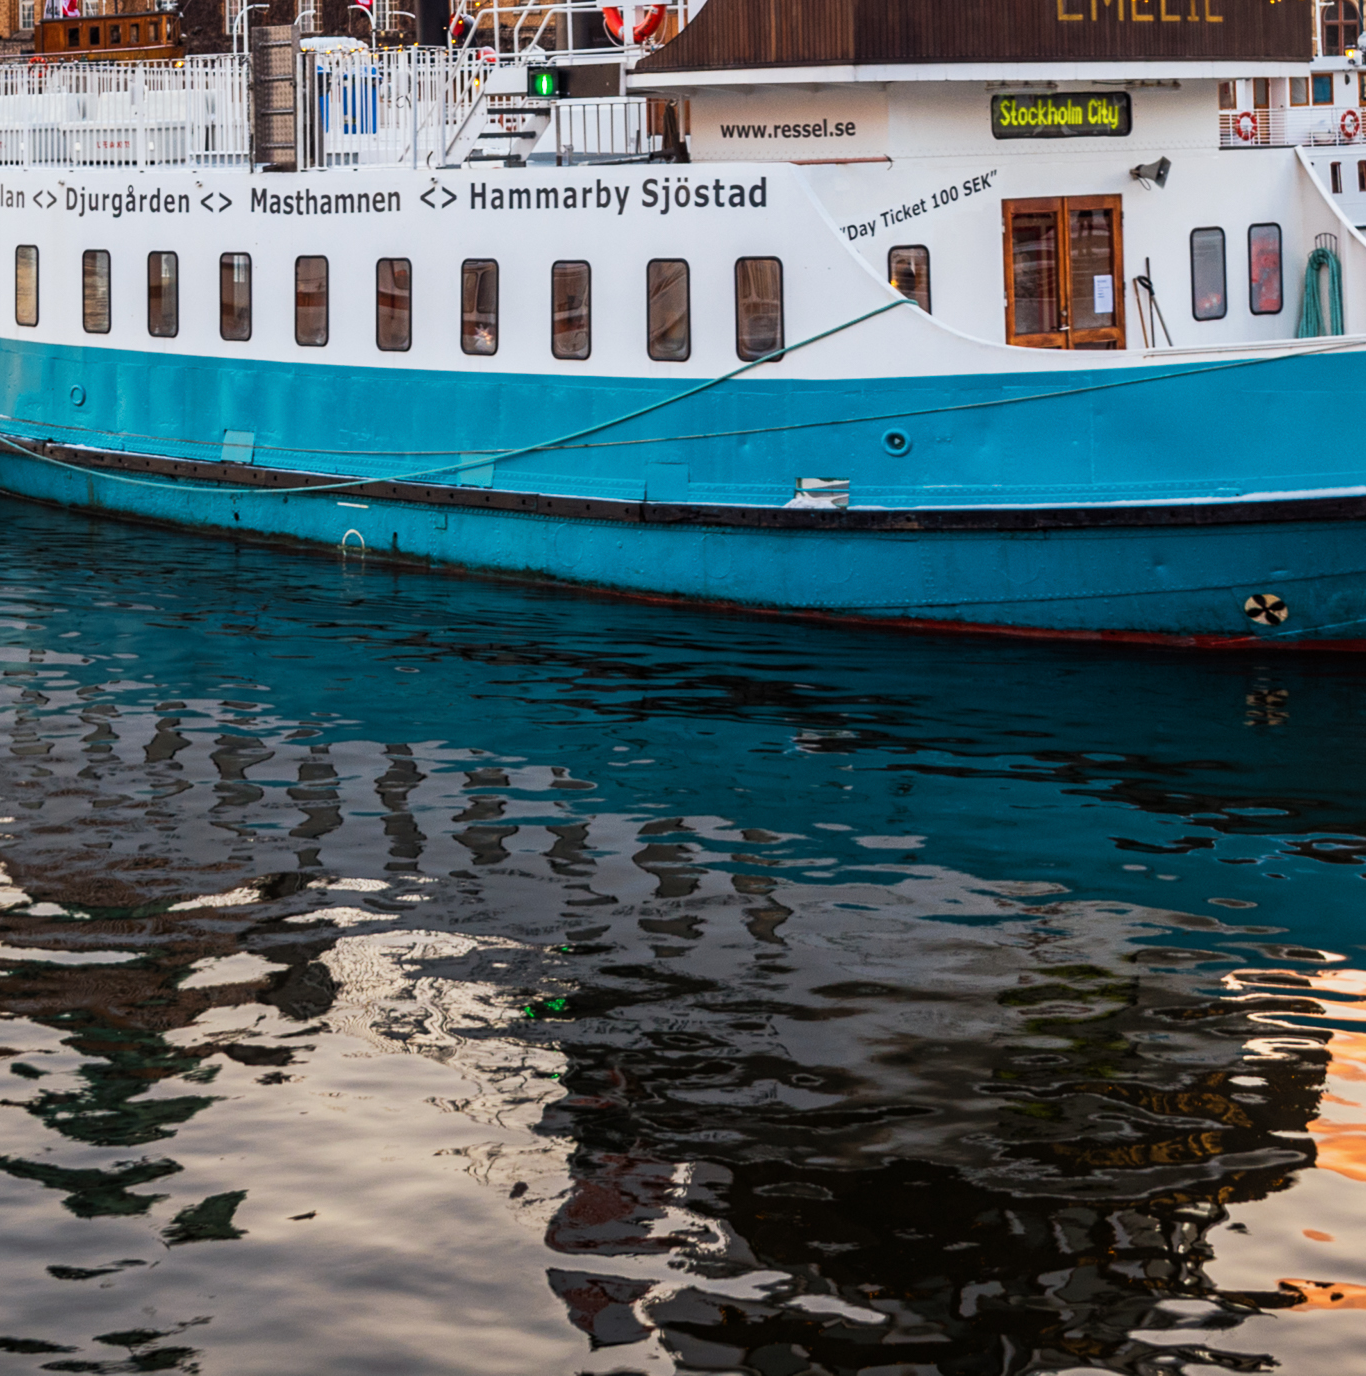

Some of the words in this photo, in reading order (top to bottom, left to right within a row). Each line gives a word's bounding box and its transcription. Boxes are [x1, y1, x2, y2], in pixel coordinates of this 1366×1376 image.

[721, 119, 856, 138] www.ressel.se
[1000, 99, 1083, 126] Stockholm
[1088, 98, 1119, 129] City
[65, 185, 190, 218] Djurgården
[250, 187, 402, 215] Masthamnen
[469, 182, 629, 215] Hammarby
[641, 176, 768, 215] Sjöstad
[880, 198, 927, 227] Ticket
[931, 185, 959, 208] 100
